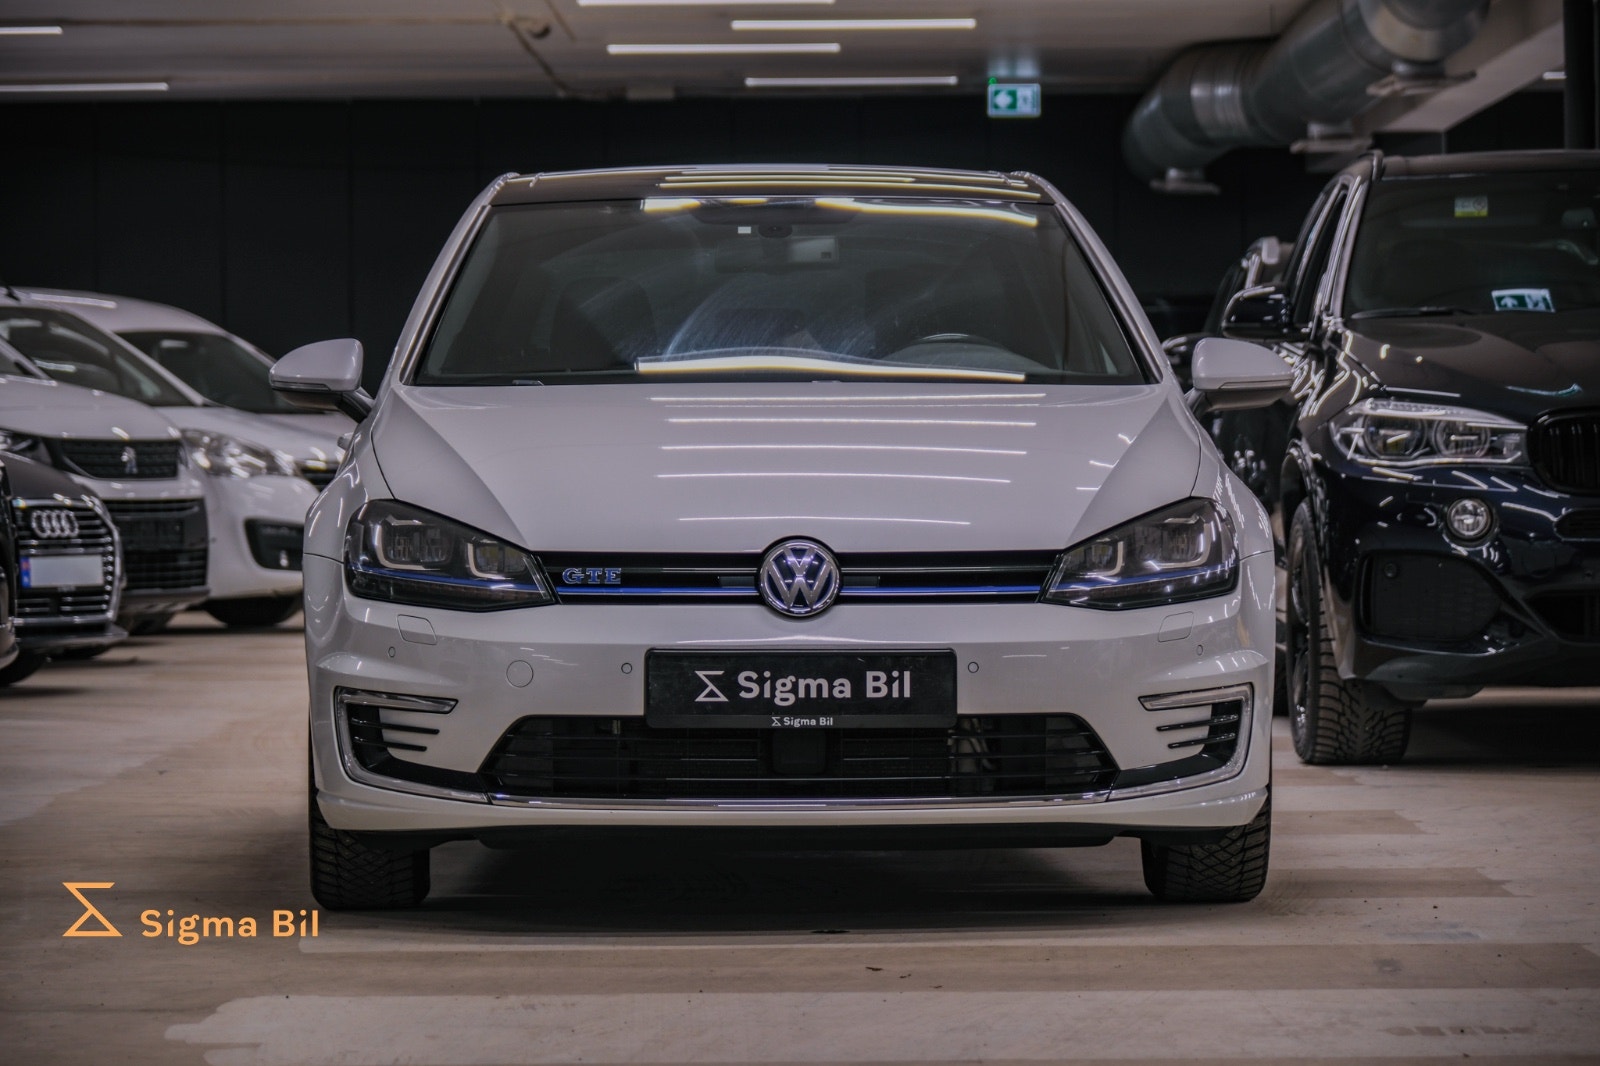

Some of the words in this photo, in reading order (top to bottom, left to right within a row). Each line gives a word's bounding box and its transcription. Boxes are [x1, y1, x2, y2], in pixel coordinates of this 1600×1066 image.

[562, 567, 622, 585] GTE
[737, 671, 851, 706] Sigma
[866, 671, 911, 698] Bil
[783, 716, 817, 728] Sigma
[819, 716, 834, 726] Bil
